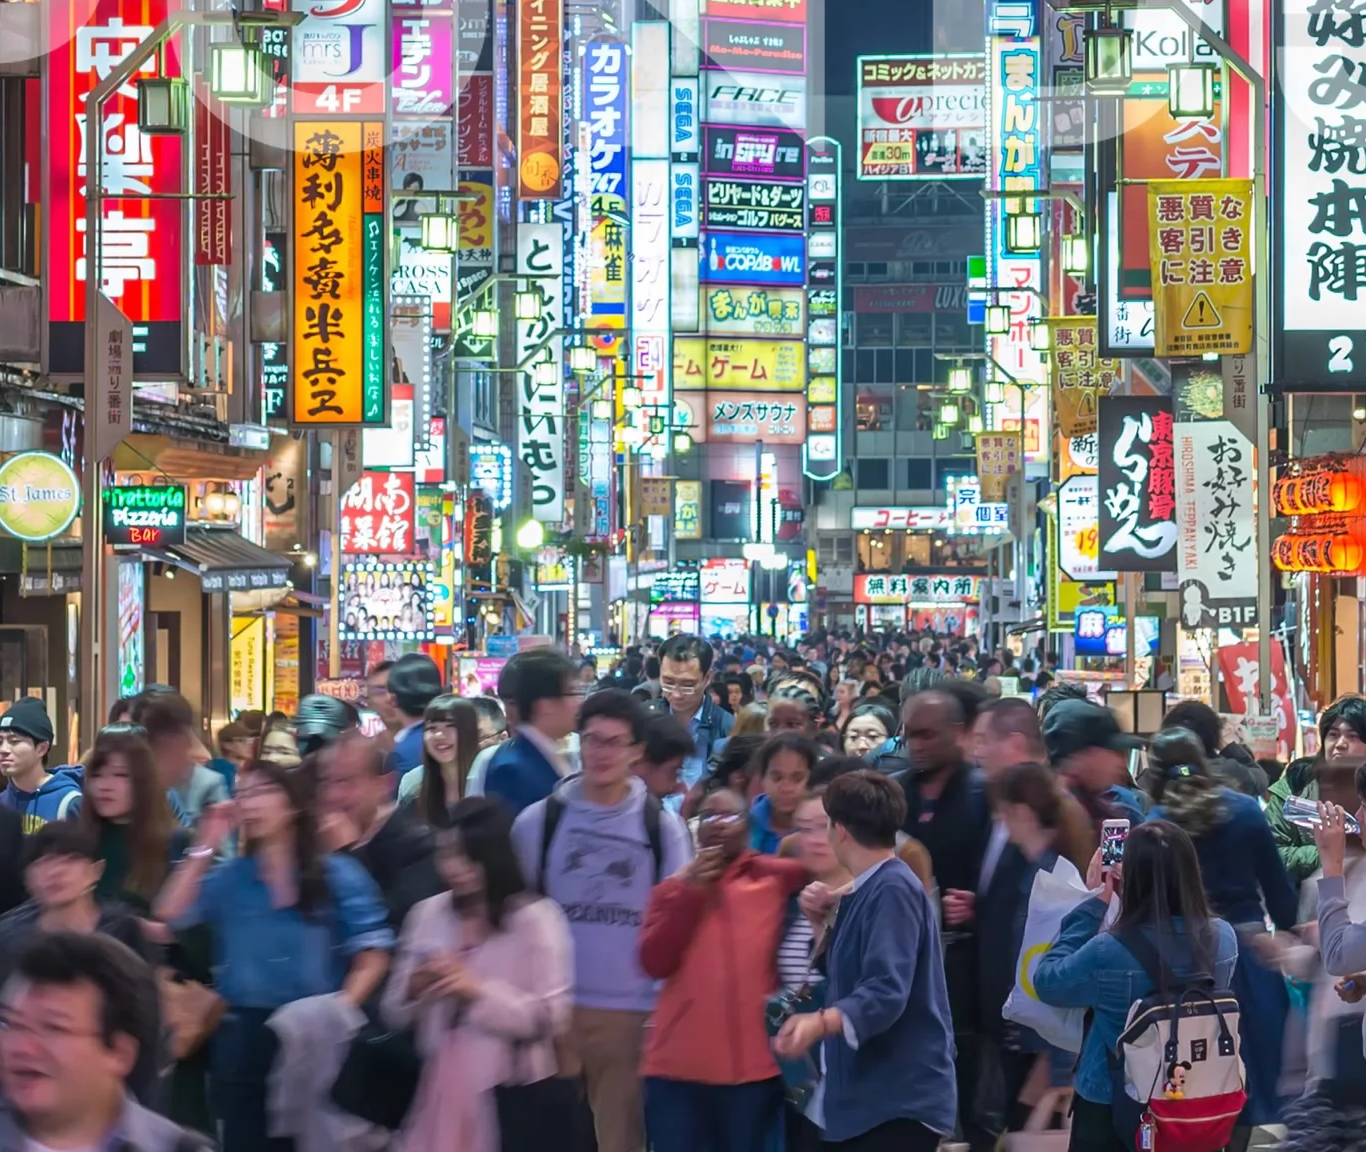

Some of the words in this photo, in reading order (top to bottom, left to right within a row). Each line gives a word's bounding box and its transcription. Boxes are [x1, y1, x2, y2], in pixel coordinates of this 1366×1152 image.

[398, 19, 431, 91] エデン
[315, 86, 361, 113] 4F
[589, 44, 623, 170] カラオケ
[711, 85, 801, 105] FACE
[674, 87, 693, 143] SEGA
[364, 130, 382, 202] 炭火串焼
[674, 174, 693, 228] SEGA
[708, 182, 803, 209] ビリヤード&ダーツ
[1158, 195, 1243, 222] 悪質な
[737, 209, 769, 227] ゴルフ
[769, 213, 803, 228] バグース
[604, 222, 623, 282] 麻雀
[1159, 226, 1243, 253] 客引き
[1160, 259, 1244, 285] に注意
[392, 280, 443, 294] CASA
[710, 289, 801, 322] まんが喫茶
[711, 355, 768, 382] ゲーム
[713, 402, 797, 422] メンズサウナ
[1148, 410, 1176, 520] 東京豚骨
[1181, 436, 1196, 494] HIROSHIMA
[874, 509, 934, 527] コーヒー
[1202, 435, 1252, 581] お好み焼き
[867, 578, 972, 596] 無料案内所
[1218, 607, 1257, 624] B1F
